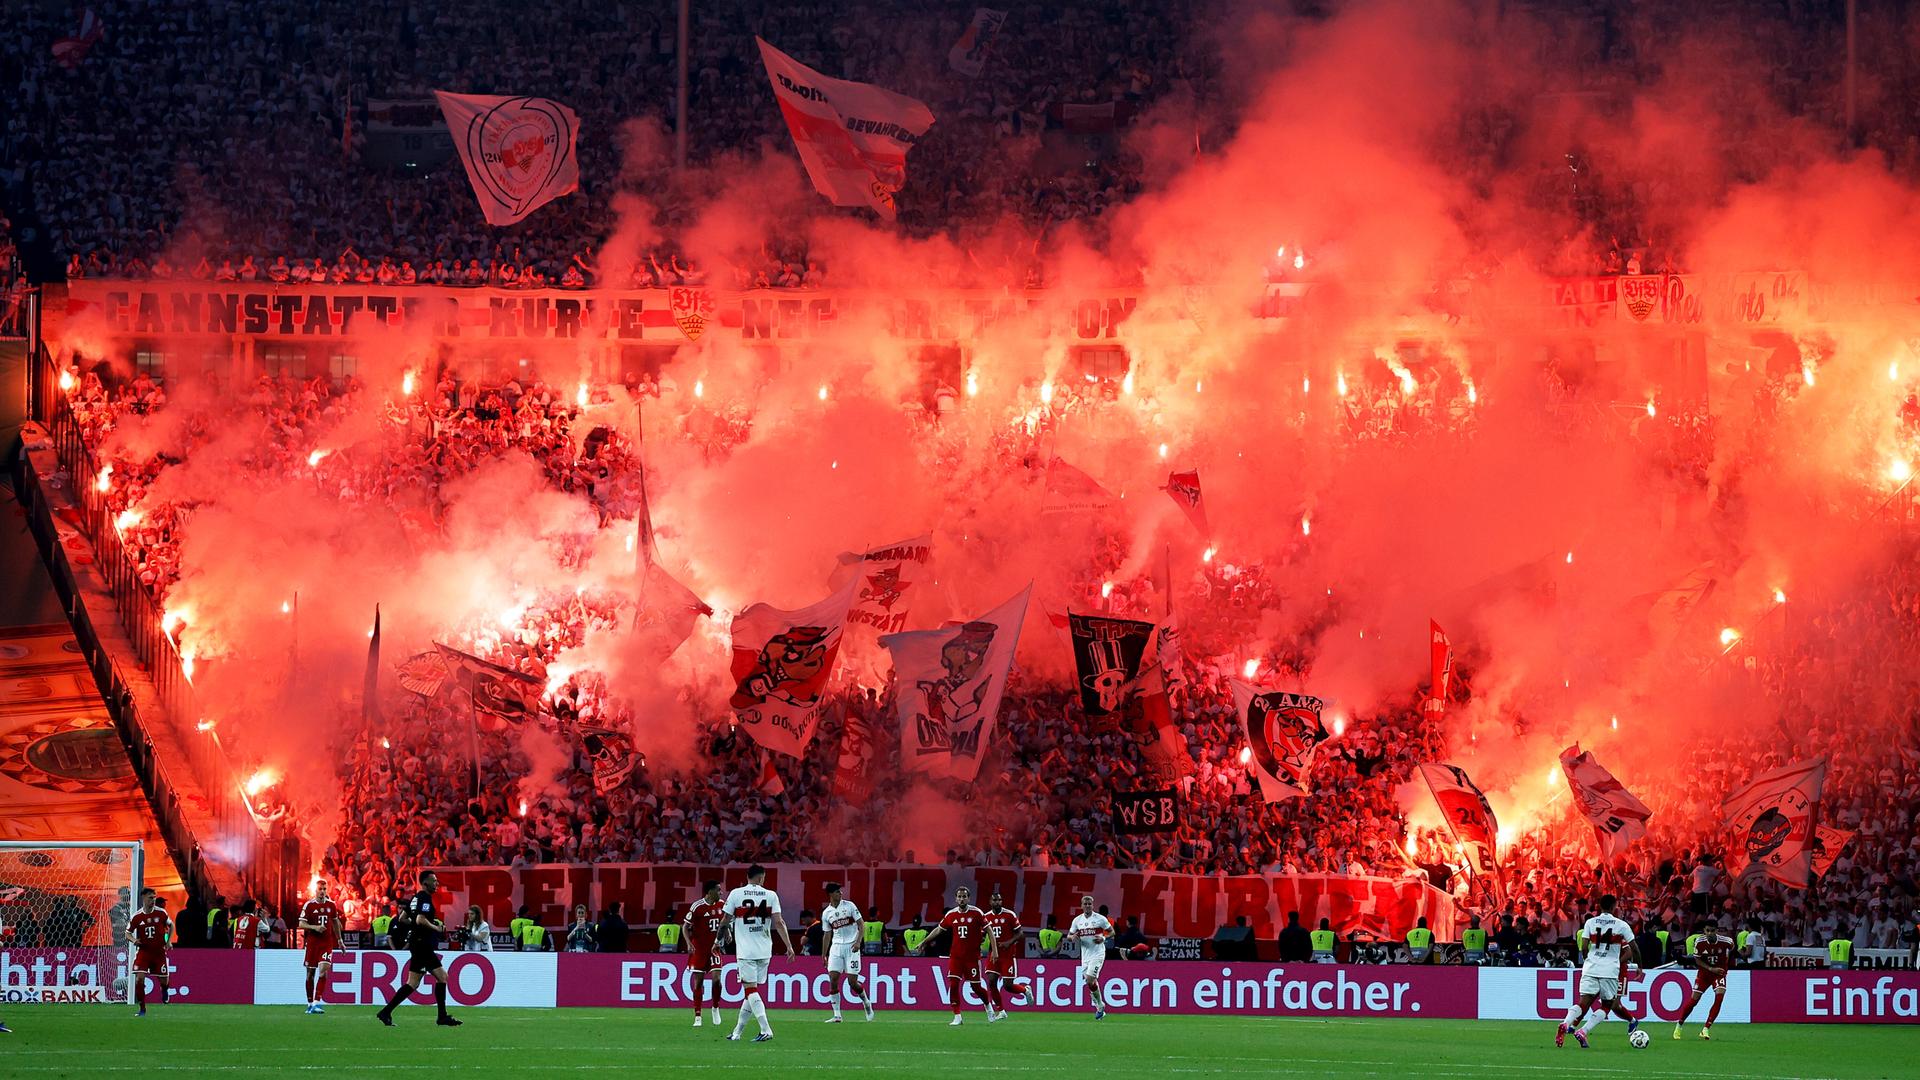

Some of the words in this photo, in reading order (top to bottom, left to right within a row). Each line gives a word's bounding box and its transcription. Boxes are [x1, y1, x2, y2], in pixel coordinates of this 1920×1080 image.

[105, 291, 460, 337] CANNSTATTR
[1115, 797, 1175, 826] WSB
[426, 867, 777, 930] FREIHE
[742, 898, 767, 924] 24
[1171, 938, 1201, 948] MAGIC
[1595, 926, 1612, 951] 14
[710, 955, 721, 966] 10
[850, 960, 859, 969] 30
[1172, 949, 1201, 960] FANS
[160, 965, 167, 974] 6
[322, 951, 496, 1006] ERGO
[971, 967, 977, 977] 9
[1008, 966, 1014, 974] 4
[41, 989, 100, 1003] BANK
[621, 961, 746, 1002] ERGO
[932, 964, 1177, 1008] Vesichern
[1193, 967, 1421, 1012] einfacher.
[1537, 969, 1693, 1022] EGO
[1806, 975, 1918, 1016] Einfa
